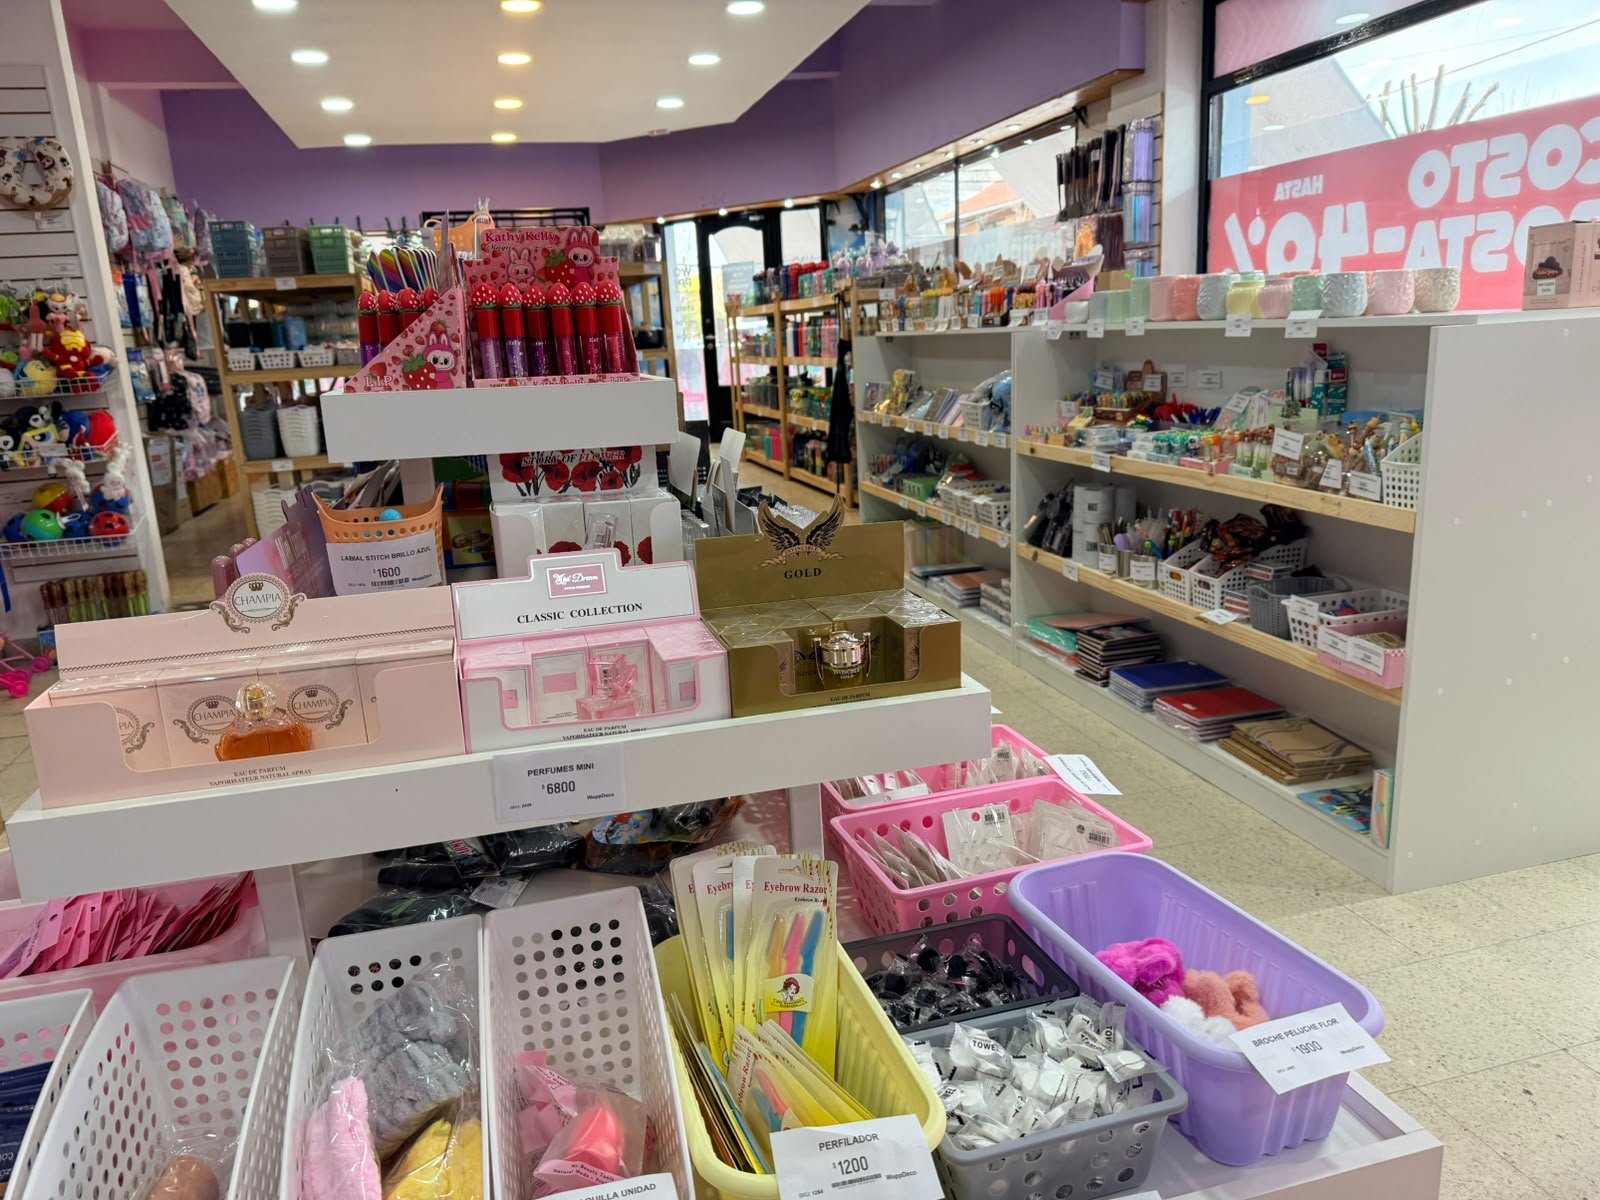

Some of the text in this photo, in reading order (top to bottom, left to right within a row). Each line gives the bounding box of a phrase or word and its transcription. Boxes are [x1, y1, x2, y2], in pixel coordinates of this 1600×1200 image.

[485, 231, 556, 244] Kathy Kelly
[364, 375, 393, 388] LIP
[521, 455, 560, 467] STORY
[562, 453, 578, 464] OF
[340, 554, 364, 562] LABIAL
[391, 549, 416, 559] BRILLO
[416, 546, 431, 555] AZUL
[784, 567, 822, 580] GOLD
[234, 592, 282, 606] CHAMPIA
[517, 602, 643, 625] CLASSIC COLLECTION
[293, 698, 335, 711] CHAMPIA
[193, 708, 236, 722] CHAMPIA
[248, 768, 258, 776] DE
[258, 765, 287, 774] PARFUM
[527, 762, 595, 777] PERFUMES MINI
[209, 768, 313, 787] VAPORISATEUR NATURAL SPRAY
[541, 780, 576, 795] $6800
[764, 881, 801, 895] Eyebrow
[803, 882, 828, 894] Razor
[1252, 1017, 1340, 1048] BROCHE PELUCHE FLOR
[818, 1133, 880, 1152] PERFILADOR
[832, 1155, 869, 1176] $1200
[620, 1183, 657, 1198] UNIDAD
